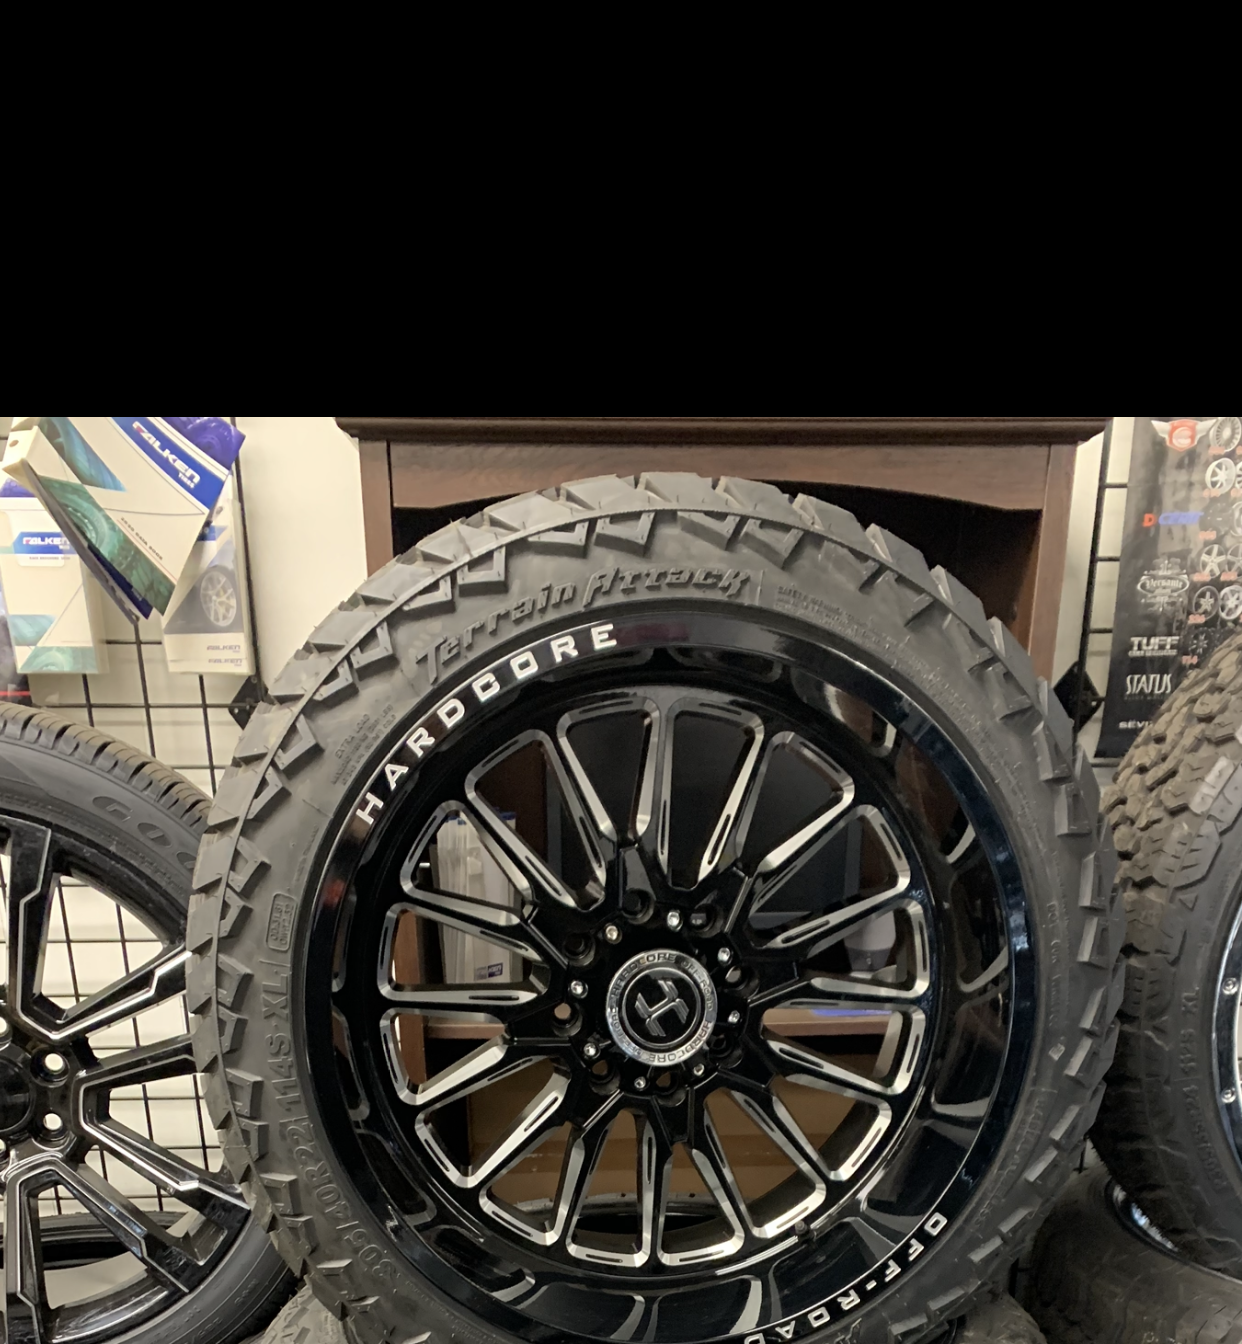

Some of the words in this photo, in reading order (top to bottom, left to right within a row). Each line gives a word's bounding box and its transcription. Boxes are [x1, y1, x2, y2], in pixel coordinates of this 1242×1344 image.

[132, 421, 200, 484] FALKEN
[416, 582, 576, 686] Terrain
[582, 565, 752, 608] Attack
[1130, 636, 1179, 651] TUFF
[1126, 674, 1172, 694] STATUS
[356, 623, 617, 825] HARDCORE
[611, 953, 677, 998] HARDCORE
